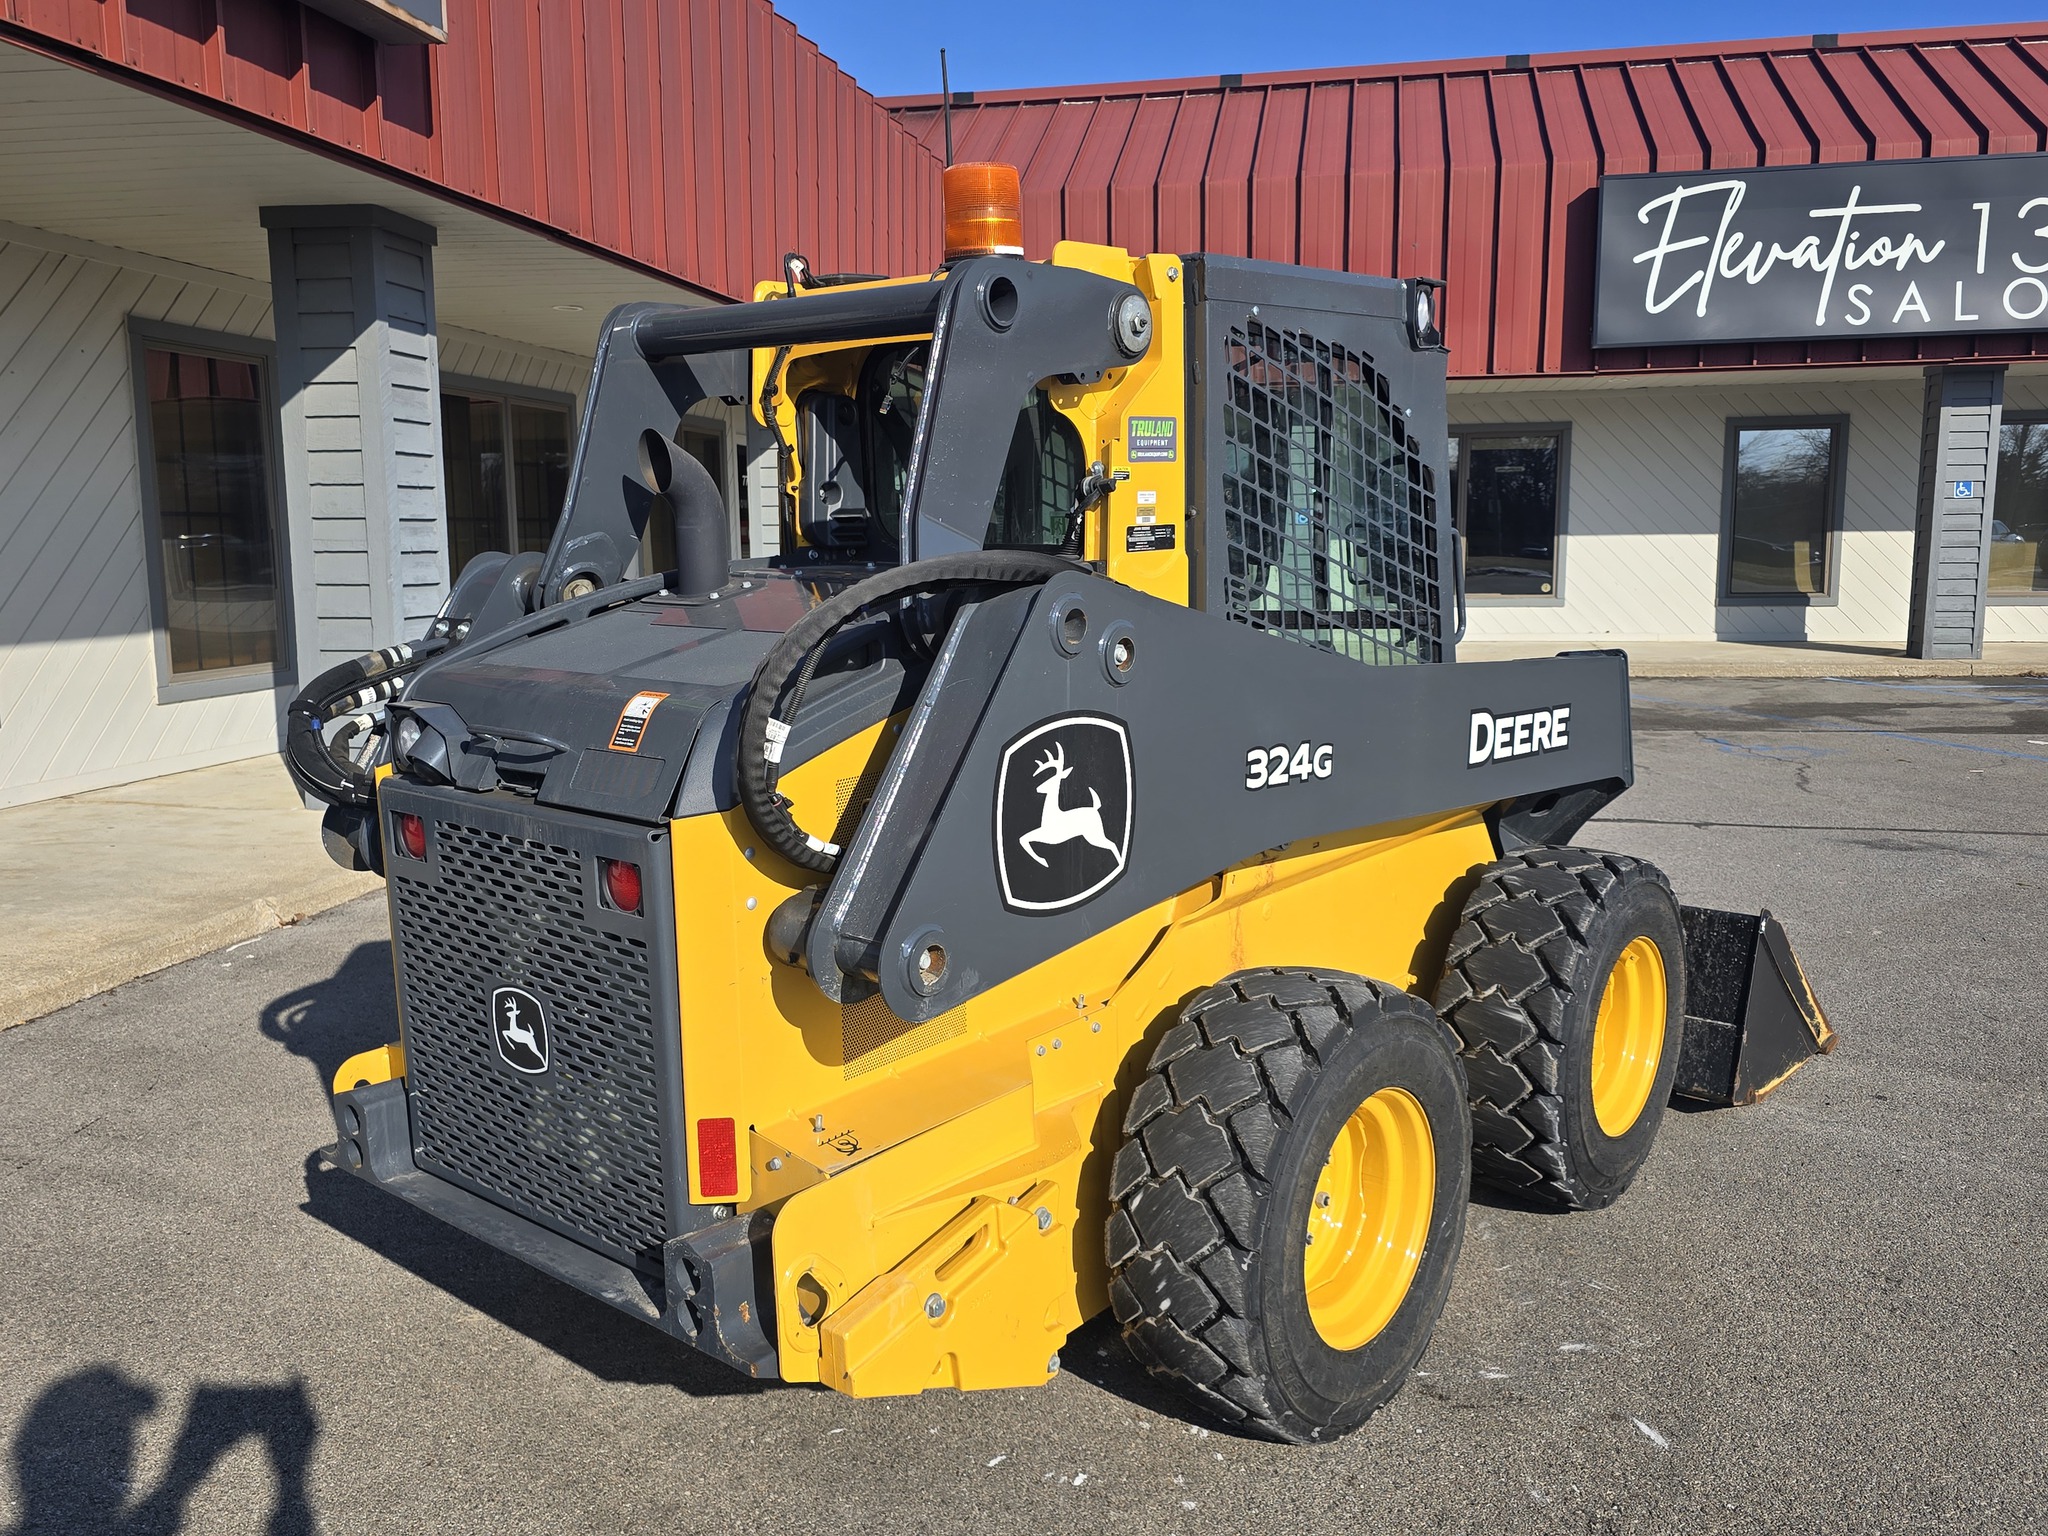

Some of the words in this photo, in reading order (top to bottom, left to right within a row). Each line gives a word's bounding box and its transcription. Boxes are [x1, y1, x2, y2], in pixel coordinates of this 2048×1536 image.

[1633, 180, 1946, 327] Elevation
[1972, 196, 2048, 275] 13
[1844, 276, 2048, 326] SALO
[1131, 420, 1174, 437] TRULAND
[1136, 439, 1169, 447] EQUIPMENT
[1469, 707, 1570, 765] DEERE
[1246, 743, 1333, 789] 324G
